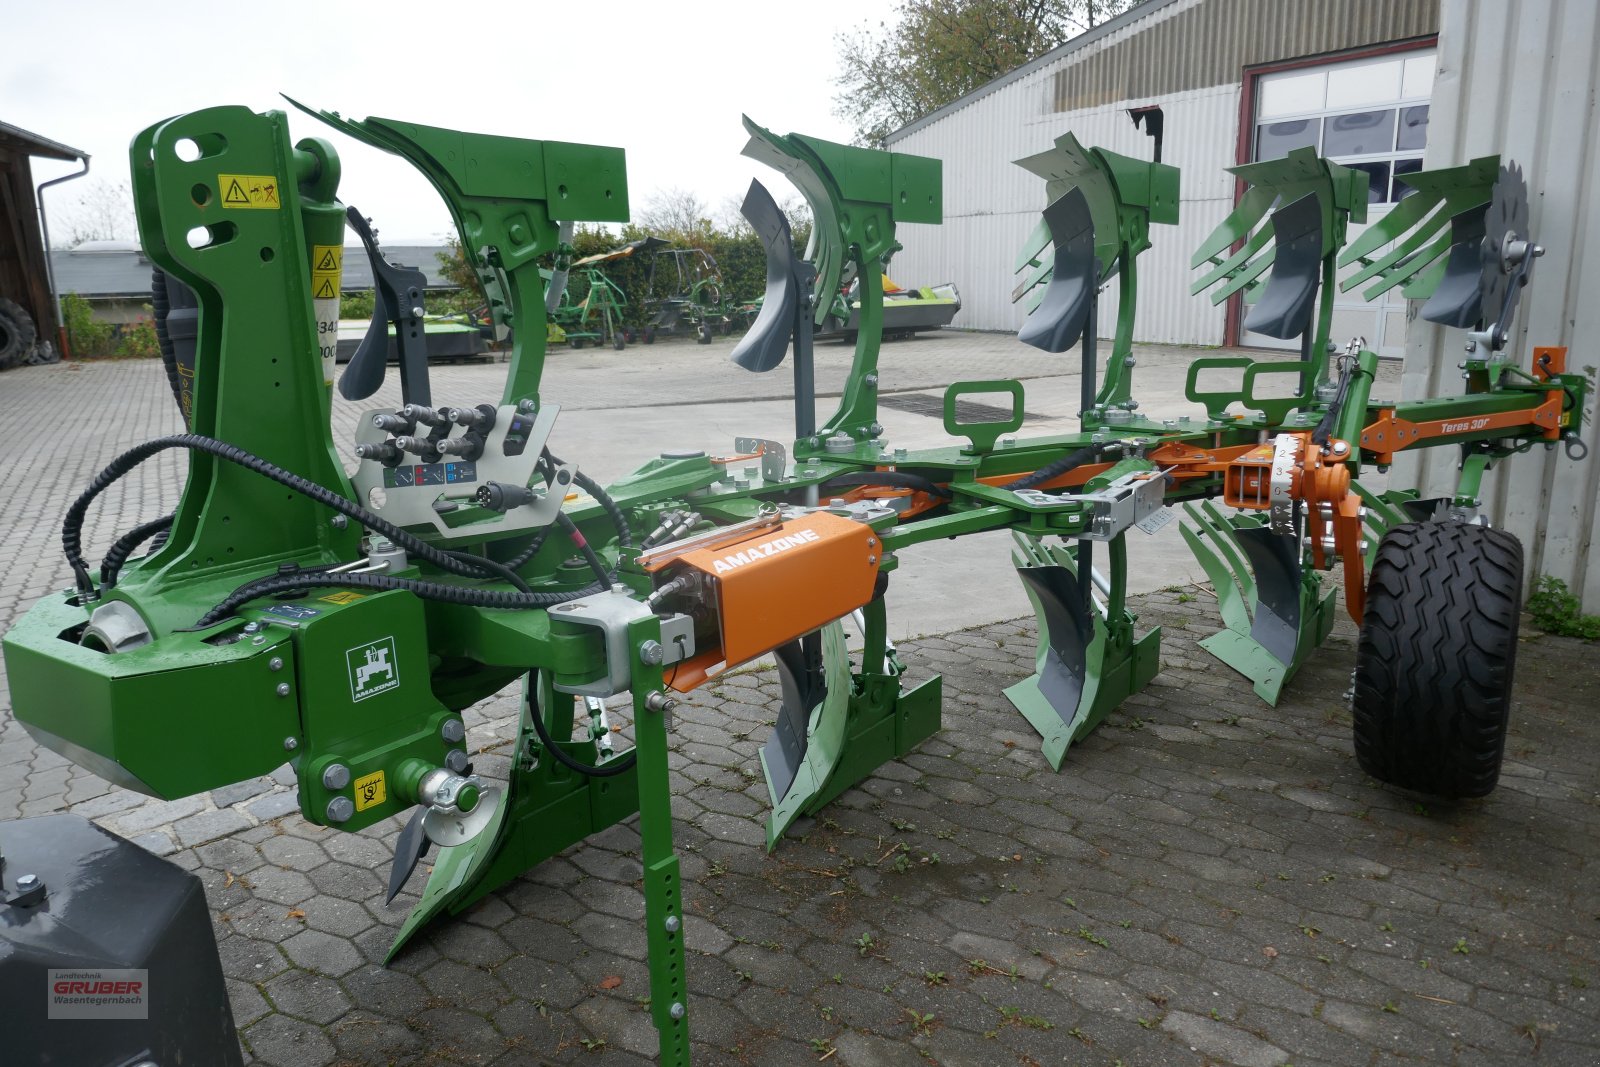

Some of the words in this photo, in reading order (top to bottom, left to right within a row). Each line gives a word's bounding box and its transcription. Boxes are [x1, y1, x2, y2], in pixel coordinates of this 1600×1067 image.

[1441, 422, 1470, 434] Teres
[711, 528, 821, 575] AMAZONE
[354, 679, 398, 700] AMAZONE
